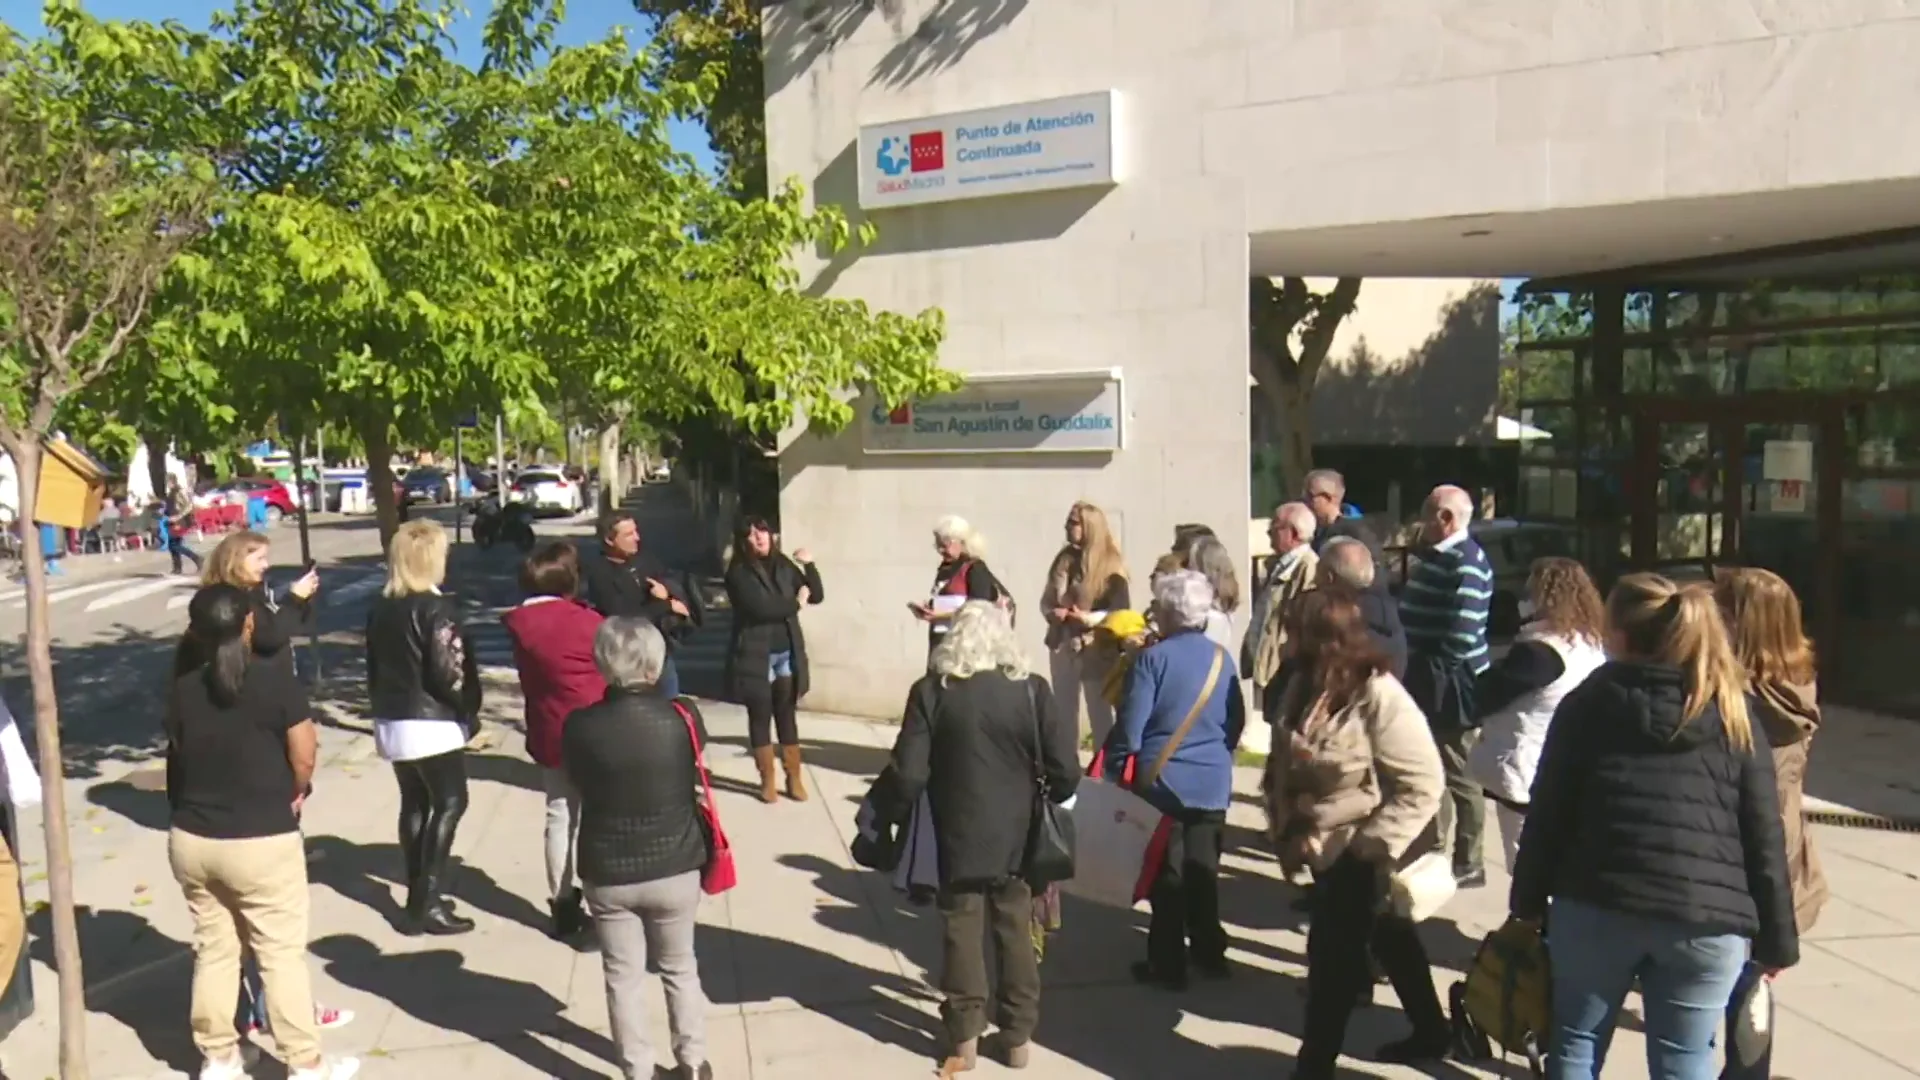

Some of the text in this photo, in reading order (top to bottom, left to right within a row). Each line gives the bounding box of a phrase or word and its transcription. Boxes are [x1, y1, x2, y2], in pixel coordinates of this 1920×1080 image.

[956, 111, 1094, 141] Punto de Atención
[957, 140, 1042, 161] Continuada
[913, 416, 944, 433] San
[948, 413, 1009, 436] Agustín
[1013, 415, 1034, 431] de
[1038, 413, 1113, 431] Guadalix
